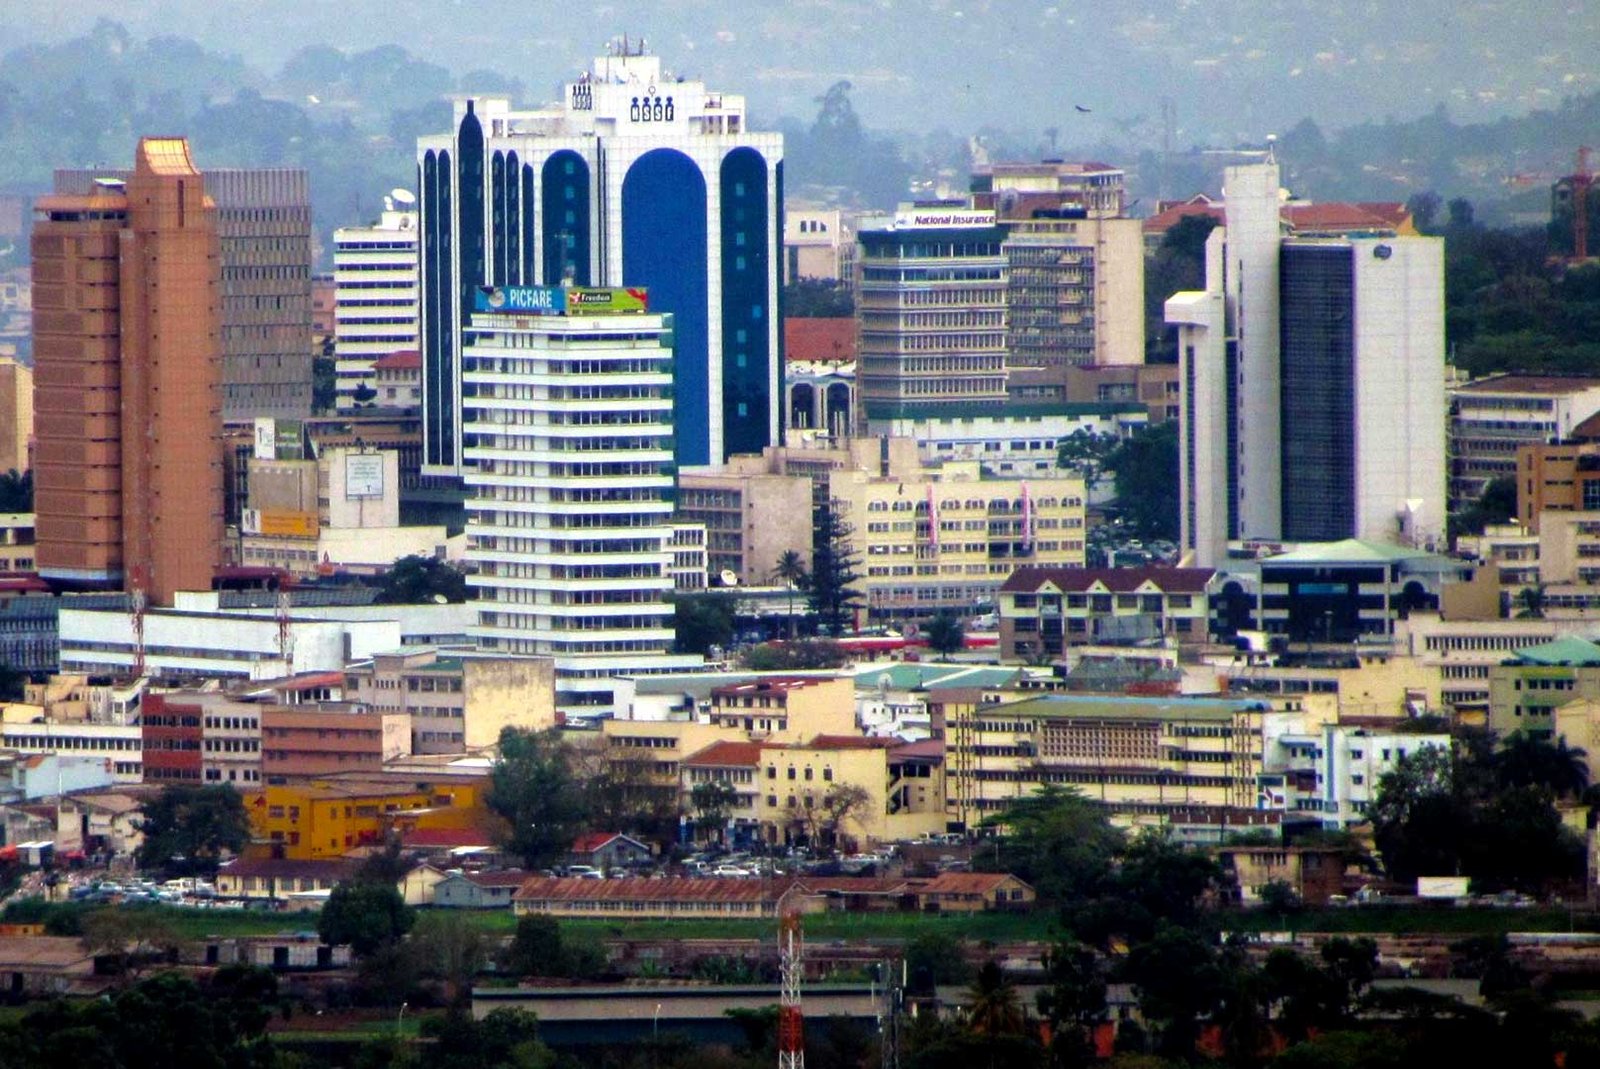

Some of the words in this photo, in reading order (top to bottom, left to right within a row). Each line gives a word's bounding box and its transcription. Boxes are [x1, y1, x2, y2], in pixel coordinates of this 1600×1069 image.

[915, 215, 951, 225] National
[952, 215, 994, 224] Insurance
[510, 289, 553, 309] PICFARE
